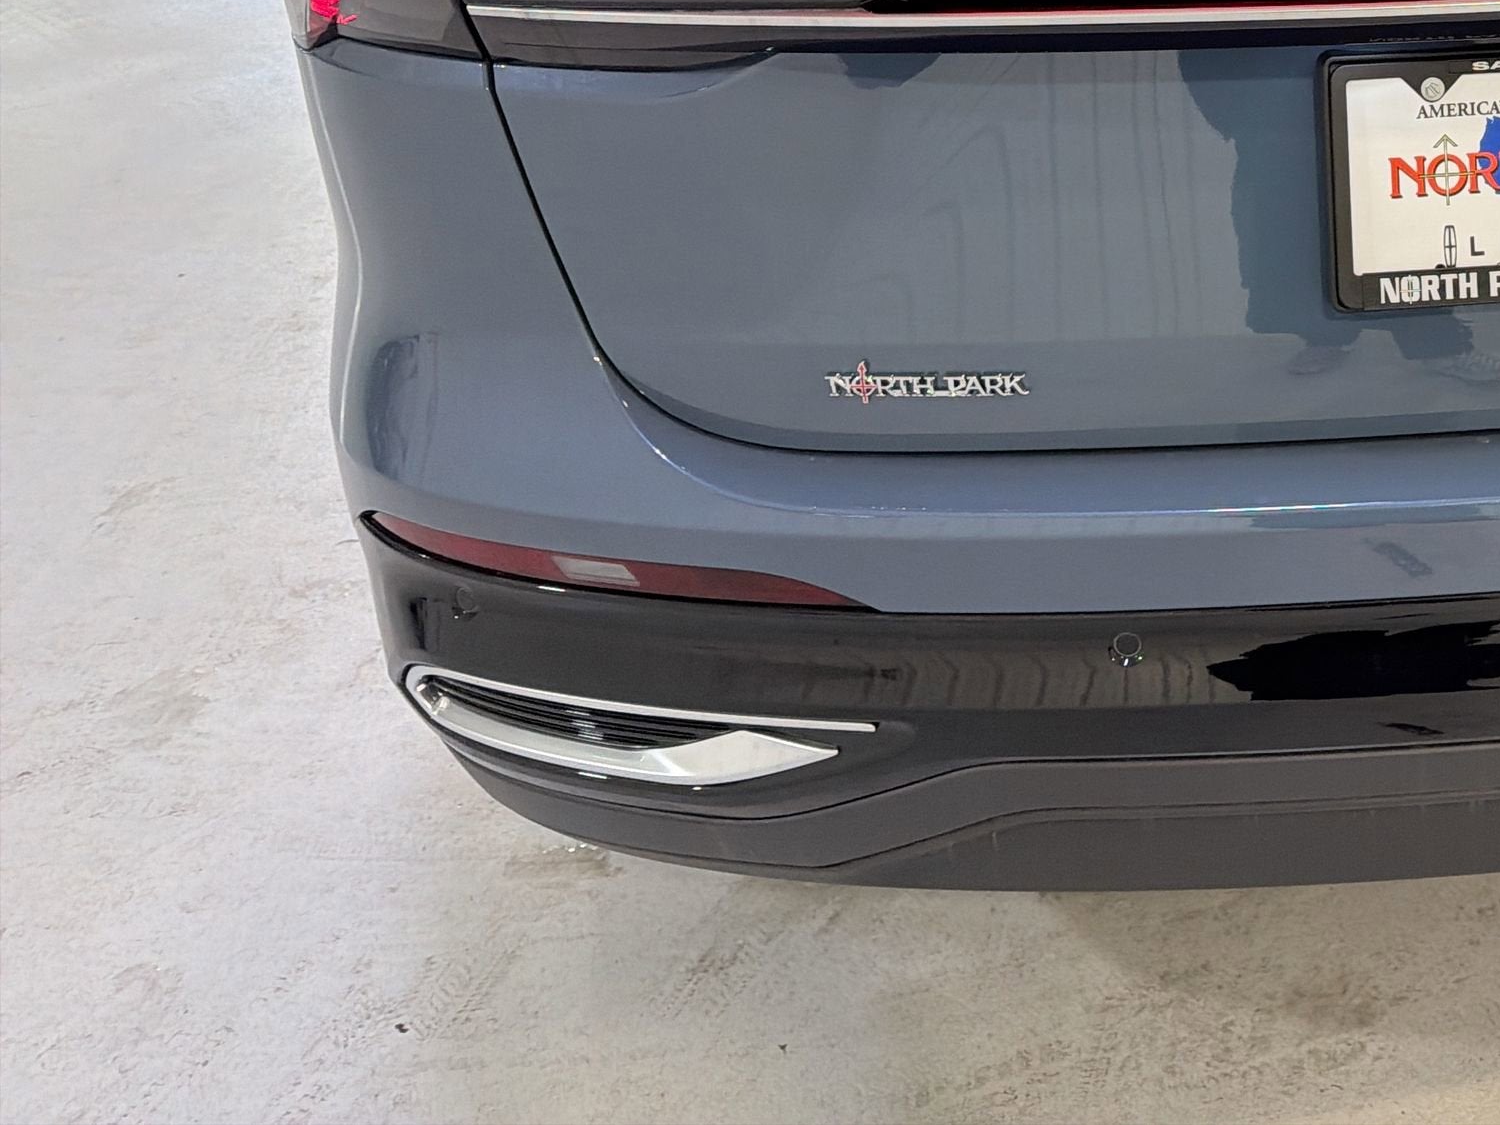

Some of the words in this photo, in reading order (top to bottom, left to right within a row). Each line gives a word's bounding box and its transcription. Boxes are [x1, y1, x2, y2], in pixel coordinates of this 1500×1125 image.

[1379, 272, 1480, 305] NORTH
[824, 373, 936, 397] NORTH
[943, 373, 1030, 397] PARK
